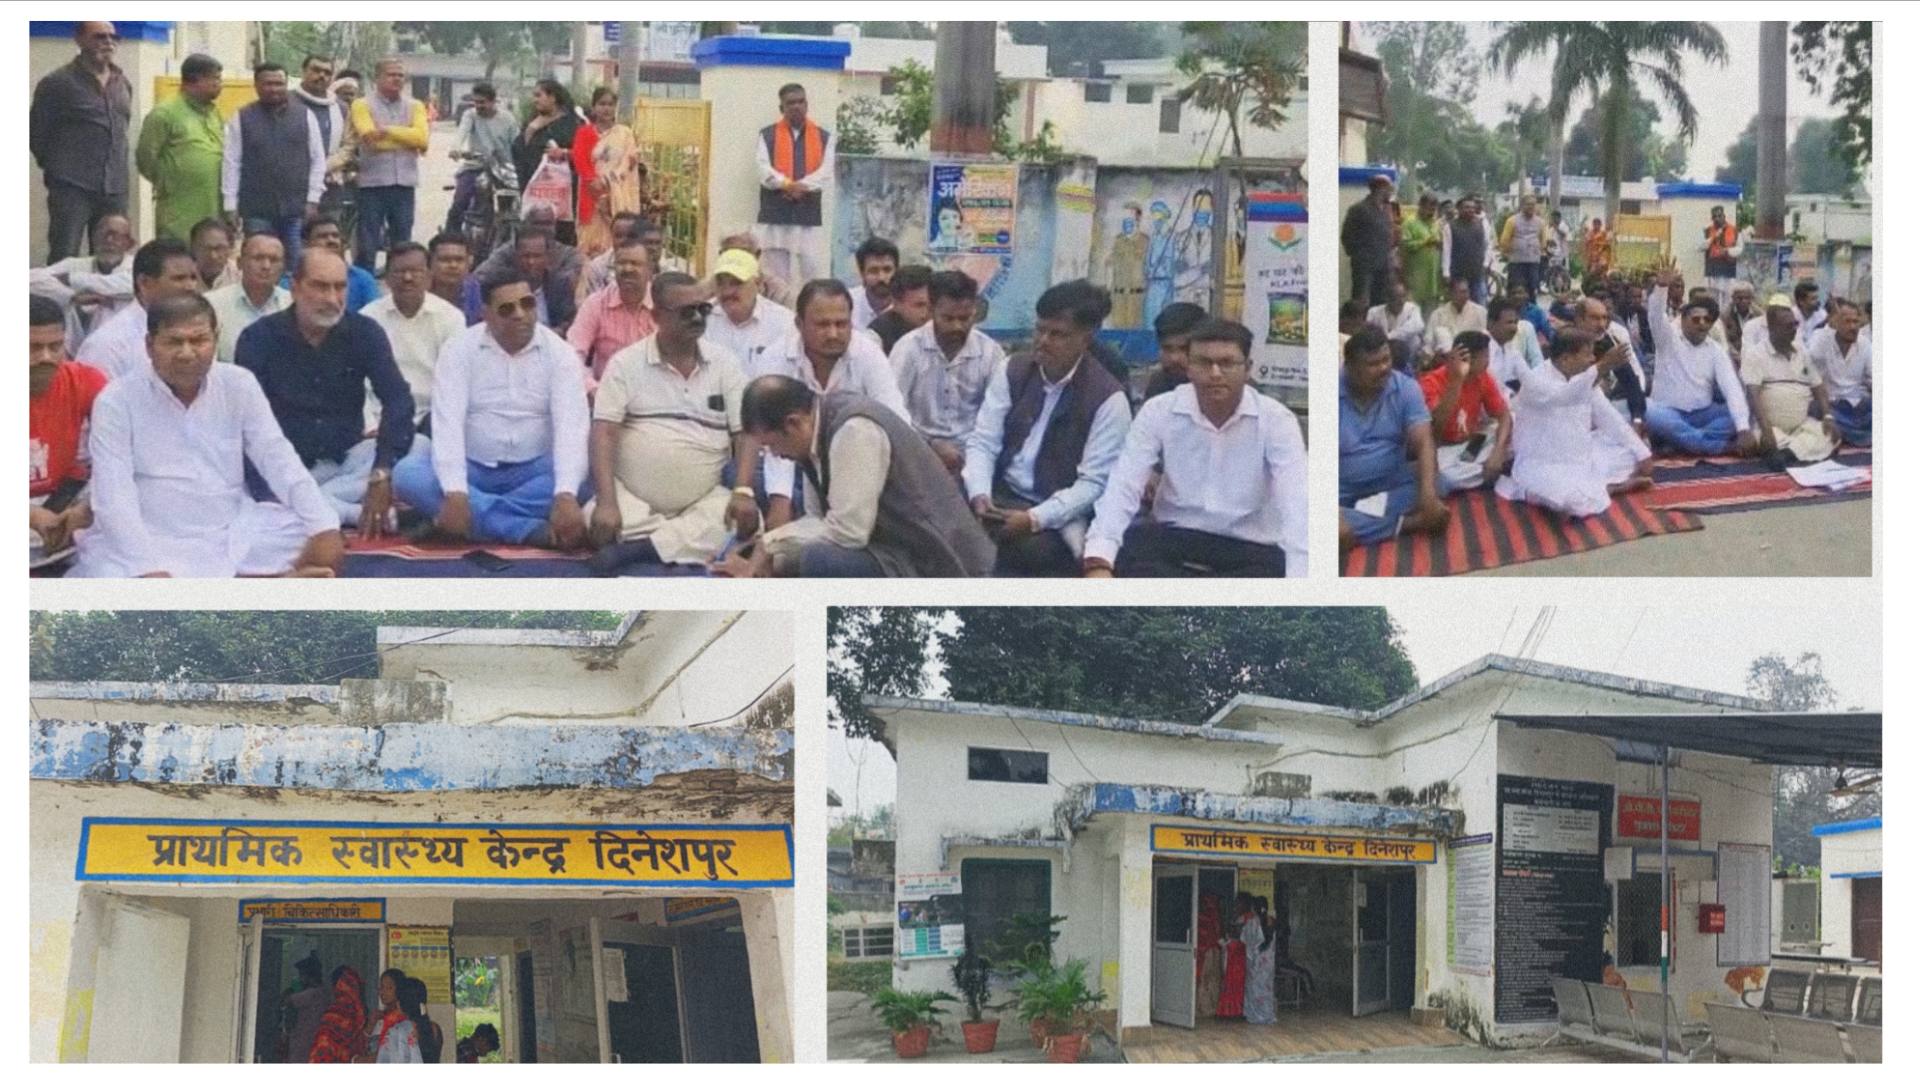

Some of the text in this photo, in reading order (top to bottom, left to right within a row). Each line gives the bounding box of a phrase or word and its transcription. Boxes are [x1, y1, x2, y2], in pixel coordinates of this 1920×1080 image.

[146, 827, 739, 881] प्राथमिक स्वास्थ्य केन्द्र दिनेशपुर
[1181, 832, 1416, 861] प्राथमिक स्वास्थ्य केन्द्र दिनेशपुर
